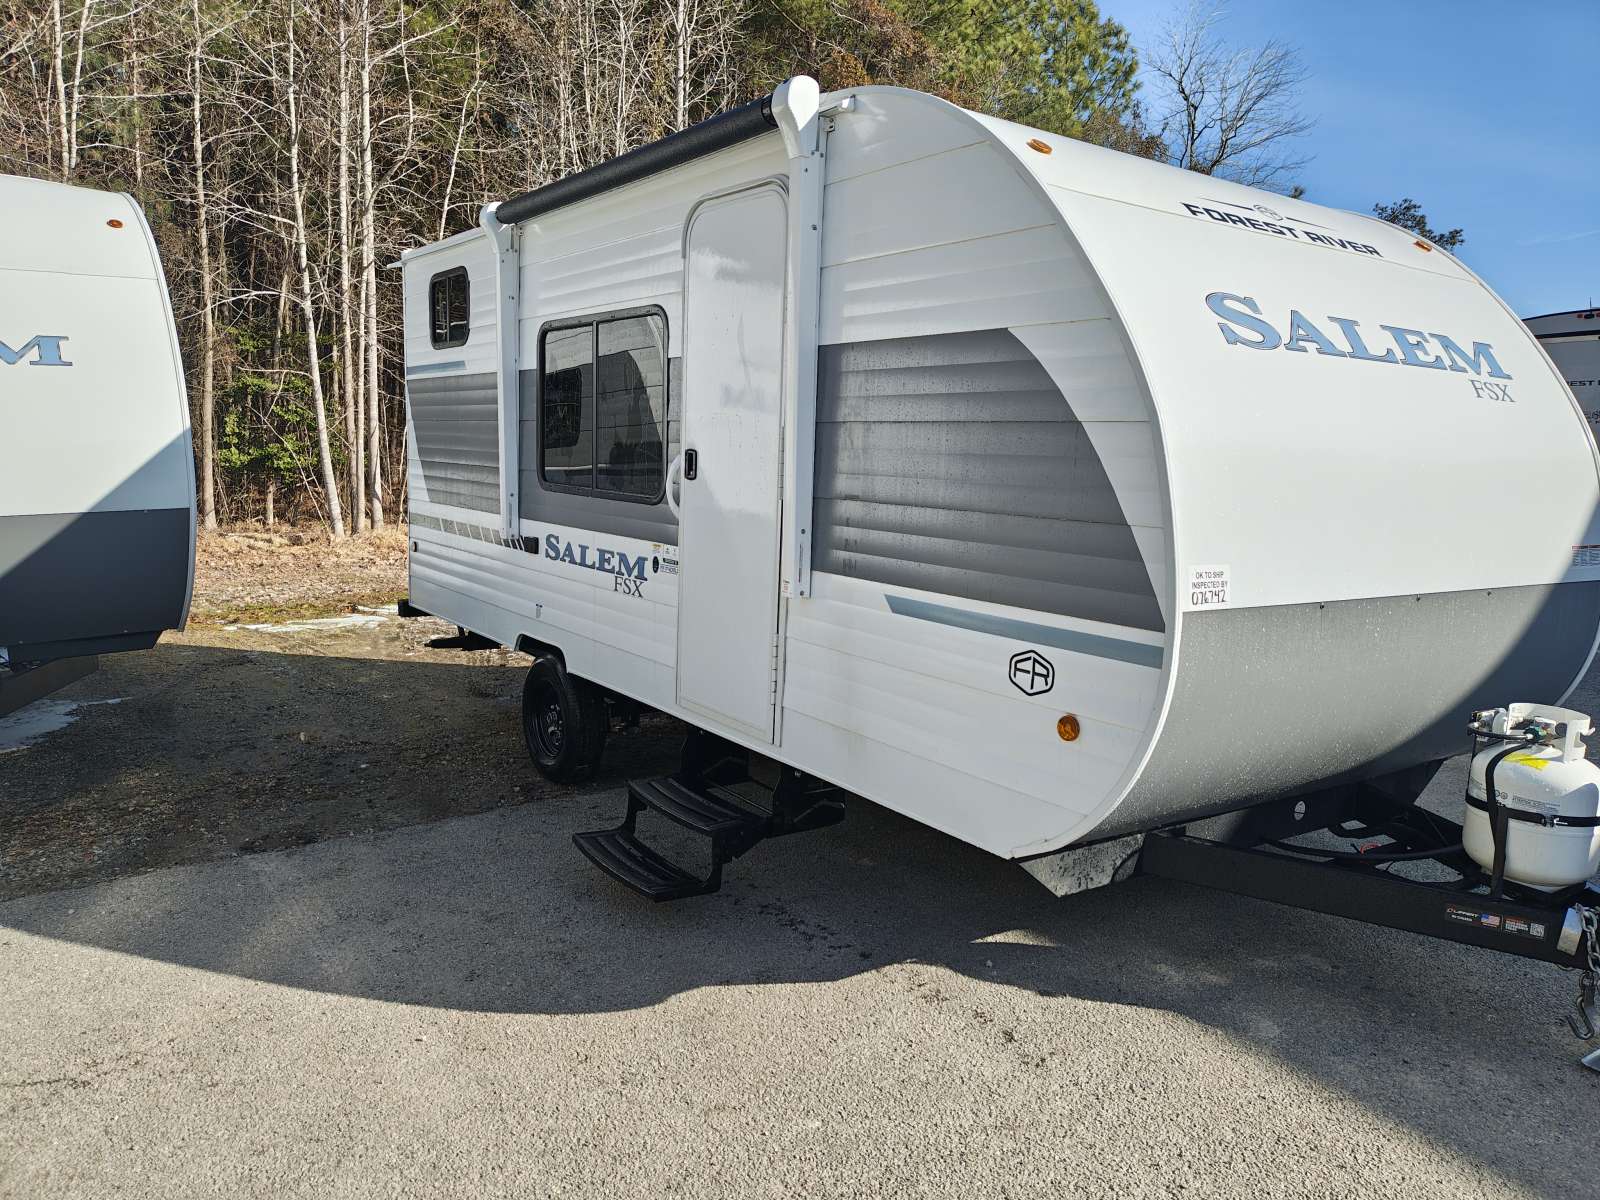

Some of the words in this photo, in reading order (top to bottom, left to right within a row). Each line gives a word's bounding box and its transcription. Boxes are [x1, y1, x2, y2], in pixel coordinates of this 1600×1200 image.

[1181, 202, 1301, 239] FOREST
[1302, 230, 1385, 258] RIVER
[1205, 291, 1513, 381] SALEM
[1467, 378, 1517, 403] FSX
[544, 533, 649, 582] SALEM
[613, 575, 645, 599] FSX
[1191, 581, 1220, 590] INSPECTED
